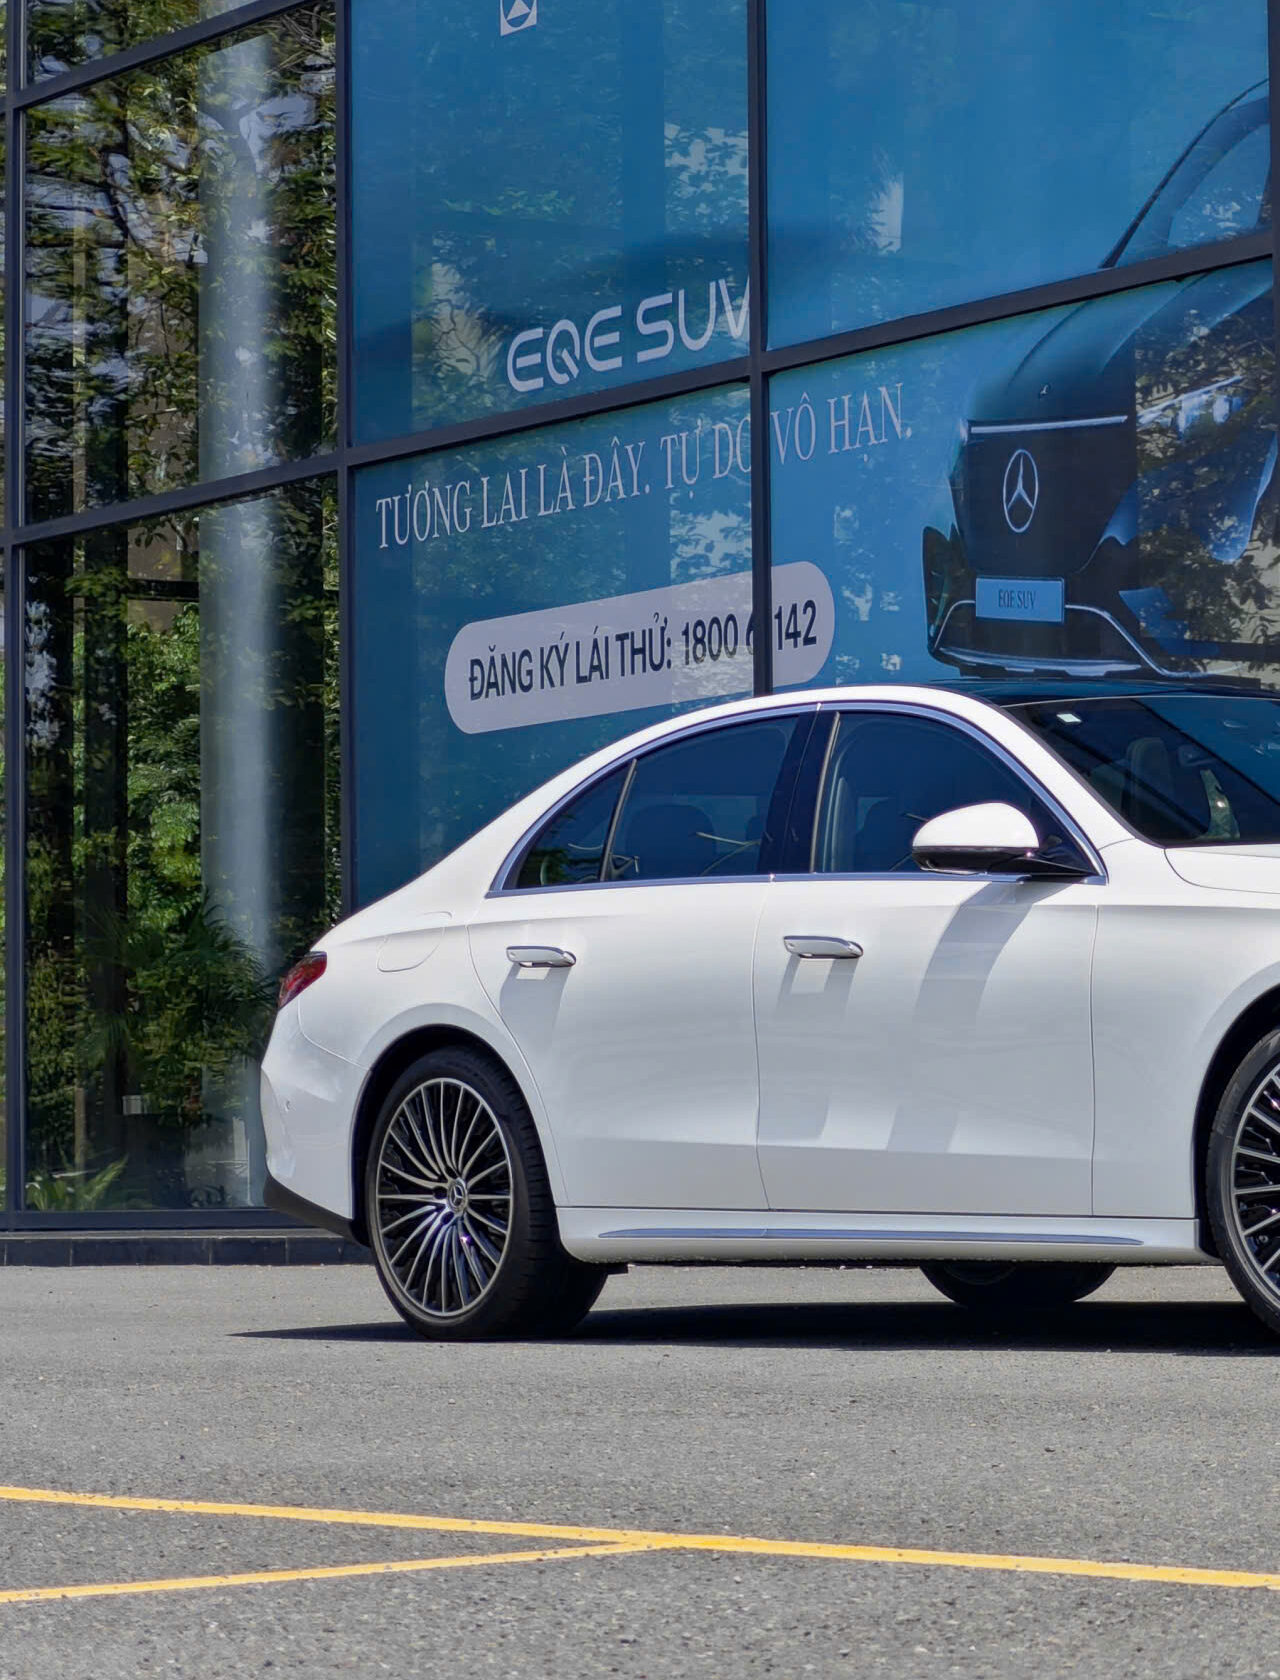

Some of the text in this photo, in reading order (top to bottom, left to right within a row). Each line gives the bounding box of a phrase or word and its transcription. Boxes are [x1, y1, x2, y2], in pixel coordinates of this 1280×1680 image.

[507, 276, 749, 392] EQE SUV
[376, 480, 473, 549] TƯƠNG
[481, 467, 529, 528] LAI
[537, 446, 576, 516] LÀ
[583, 436, 650, 507] ĐÂY.
[660, 417, 703, 499] TỰ
[770, 392, 816, 465] VÔ
[469, 645, 533, 701] ĐĂNG
[540, 632, 569, 690] KÝ
[576, 626, 609, 684] LÁI
[615, 612, 672, 677] THỬ:
[682, 613, 739, 666] 1800
